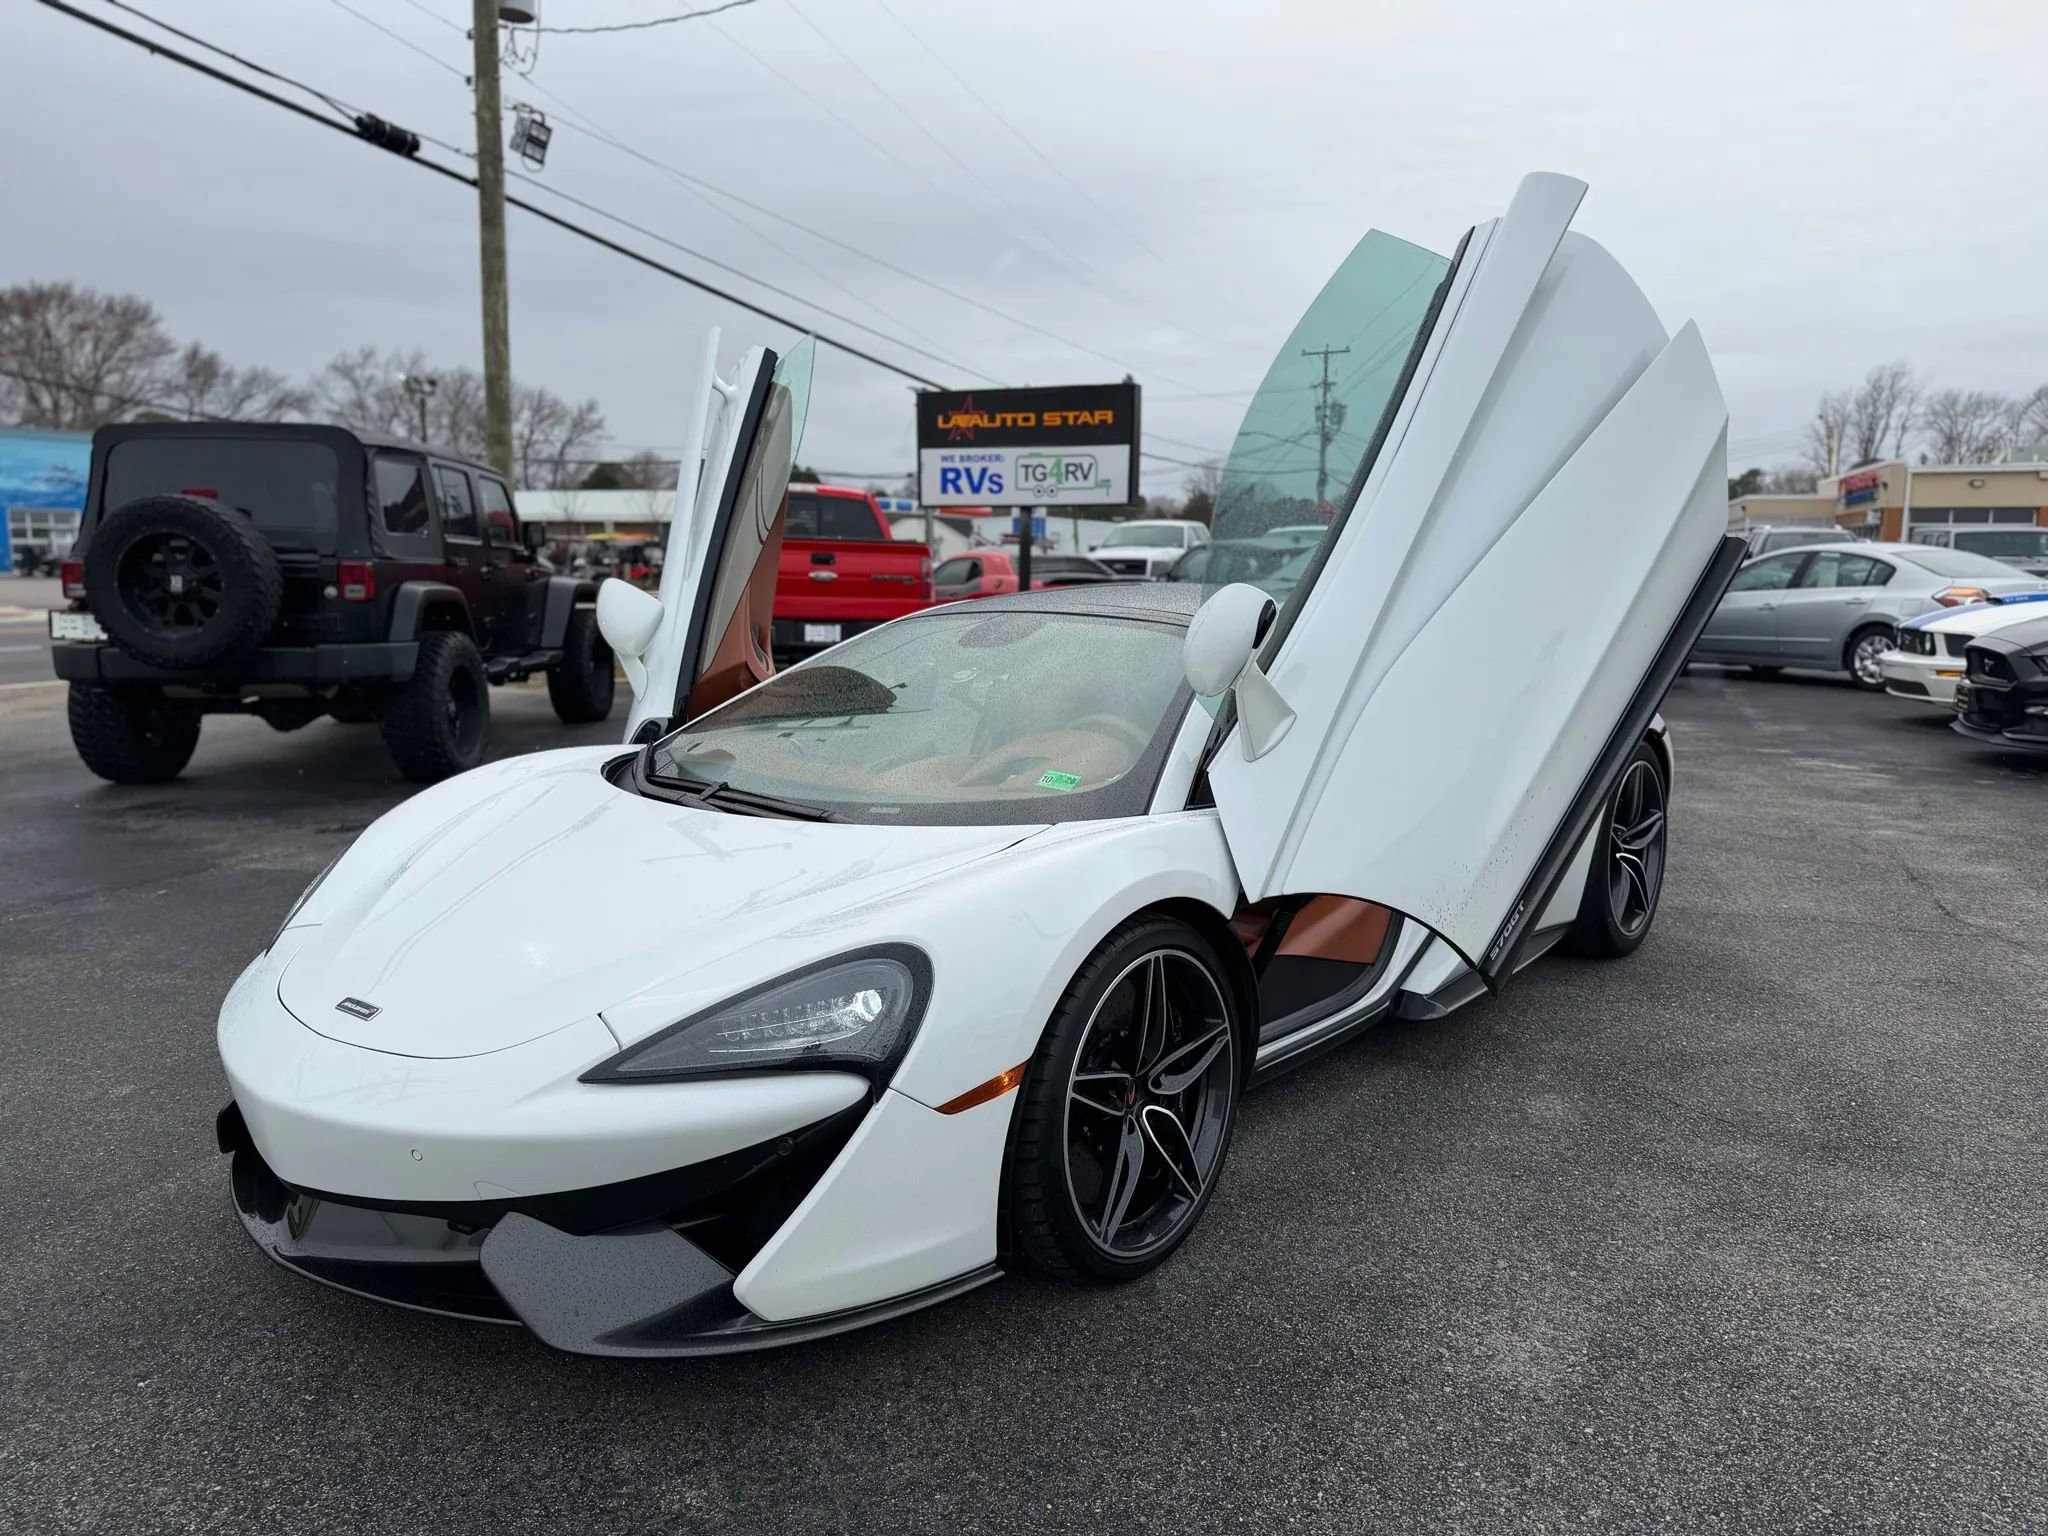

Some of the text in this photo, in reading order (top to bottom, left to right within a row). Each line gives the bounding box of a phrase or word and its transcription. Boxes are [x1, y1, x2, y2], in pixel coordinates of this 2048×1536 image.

[1043, 409, 1114, 427] STAR
[941, 454, 956, 463] WE
[1020, 456, 1093, 485] TG4RV
[941, 466, 1004, 495] RVs
[1489, 899, 1524, 961] 570GT
